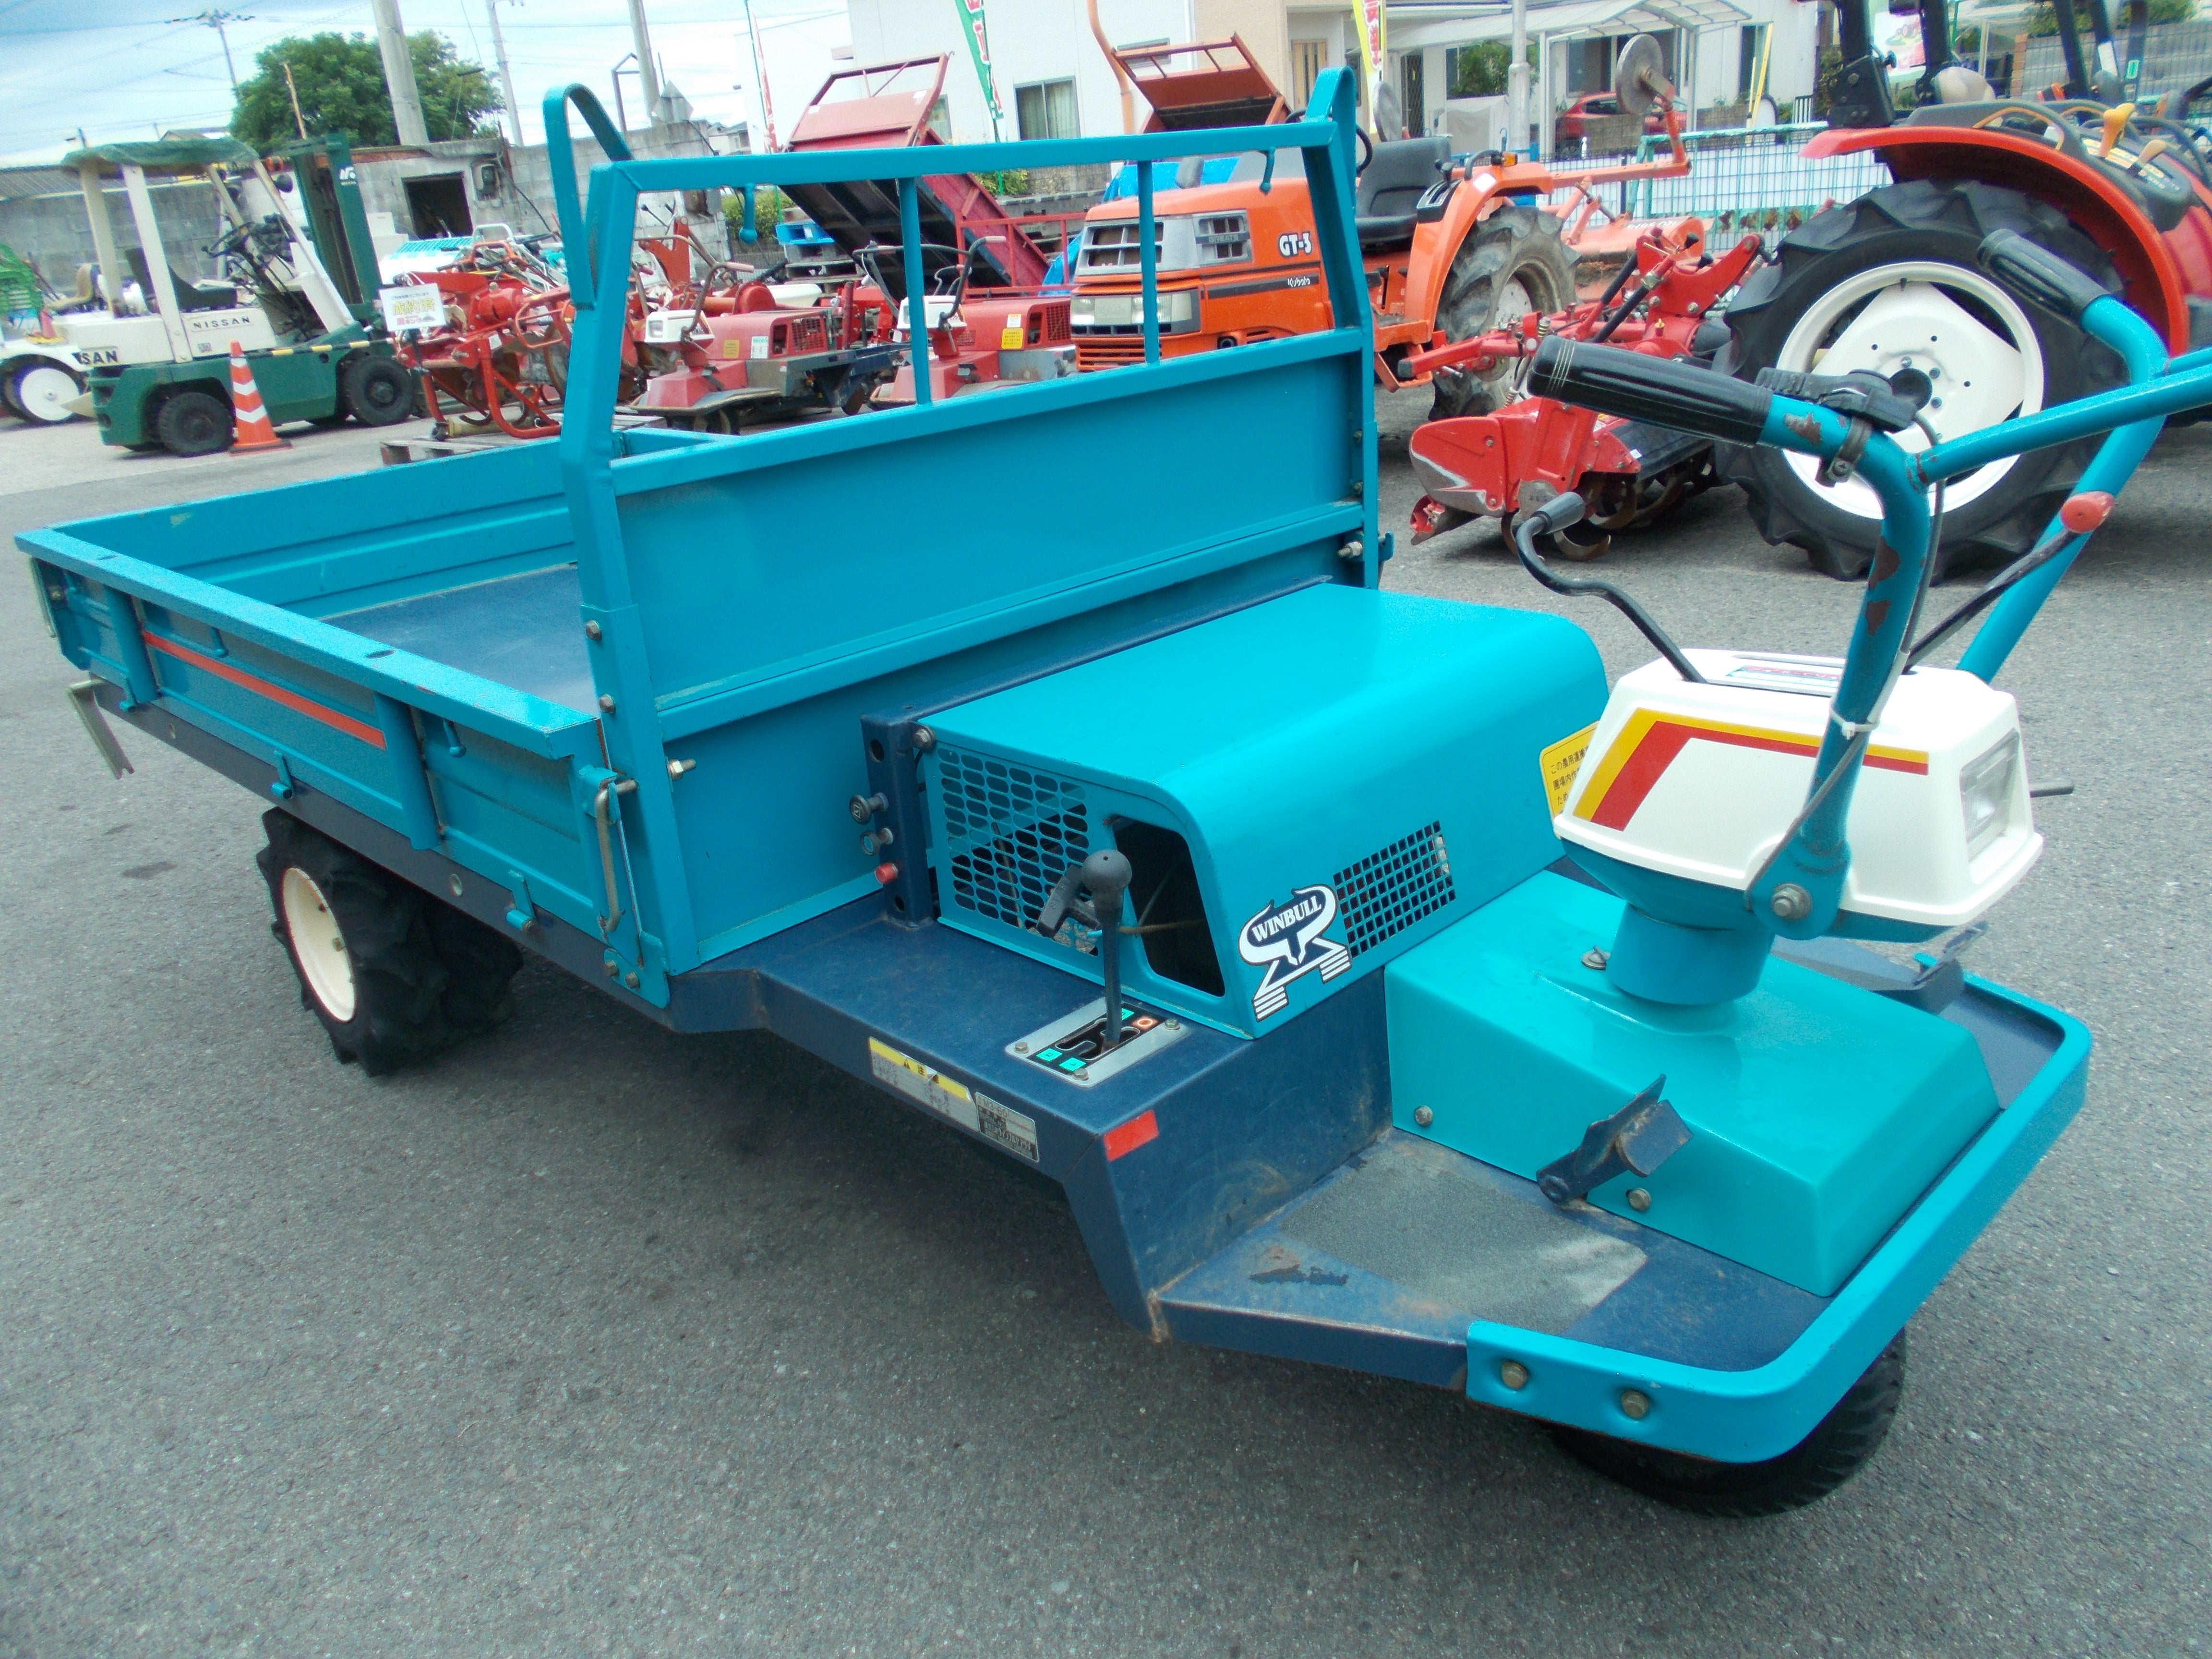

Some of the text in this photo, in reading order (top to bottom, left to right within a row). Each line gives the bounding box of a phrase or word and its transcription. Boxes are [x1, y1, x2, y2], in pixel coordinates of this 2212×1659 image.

[1279, 232, 1312, 256] GT-3
[1287, 276, 1310, 287] Kubota
[193, 317, 250, 329] NISSAN
[1251, 895, 1322, 942] WINBULL
